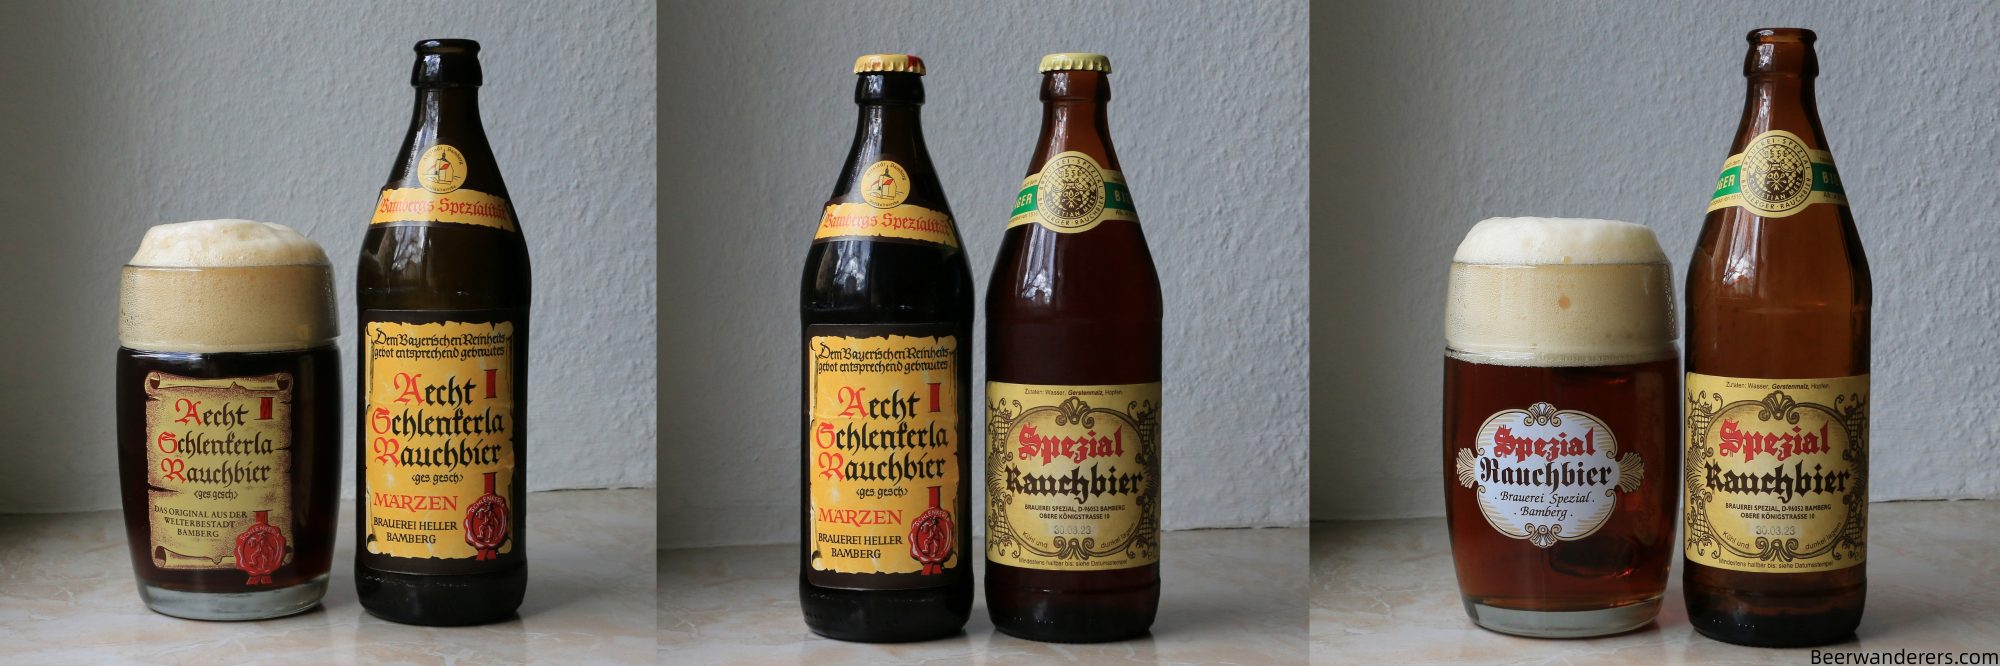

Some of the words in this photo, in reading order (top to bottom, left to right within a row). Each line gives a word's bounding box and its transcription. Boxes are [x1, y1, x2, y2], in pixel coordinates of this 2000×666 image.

[1782, 138, 1811, 170] SPEZIAL
[1076, 159, 1103, 188] SPEZIAL
[1750, 177, 1786, 200] CHRISTIAN
[1789, 177, 1803, 196] MERZ
[1780, 178, 1811, 209] RAUCHBIER
[1074, 196, 1104, 225] RAUCHBIER
[1083, 195, 1096, 212] MERZ
[374, 327, 398, 346] Dem
[399, 334, 462, 348] Bayerischen
[374, 348, 394, 360] gebot
[395, 348, 460, 361] entsprechend
[461, 346, 505, 361] gebrautes
[818, 342, 841, 360] Dem
[841, 347, 906, 362] Bayerischen
[818, 362, 838, 375] gebot
[839, 361, 903, 375] entsprechend
[904, 360, 949, 374] gebrautes
[393, 372, 476, 410] Aecht
[175, 398, 249, 432] Aecht
[837, 386, 921, 424] Aecht
[371, 406, 505, 442] Schlenkerla
[158, 431, 274, 459] Schlenkerla
[816, 420, 949, 456] Schlenkerla
[1018, 422, 1125, 466] Spezial
[1493, 424, 1597, 463] Spezial
[1719, 417, 1831, 463] Spezial
[373, 437, 502, 472] Rauchbier
[161, 457, 272, 488] Rauchbier
[818, 451, 946, 486] Rauchbier
[1480, 456, 1613, 494] Rauchbier
[1004, 462, 1144, 504] Rauchbier
[1704, 459, 1850, 504] Rauchbier
[373, 492, 459, 513] MÄRZEN
[1500, 491, 1545, 504] Brauerei
[1550, 491, 1590, 507] Spezial
[1725, 502, 1753, 511] BRAUEREI
[1754, 504, 1781, 513] SPEZIAL,
[1781, 504, 1804, 512] D-96052
[154, 504, 168, 514] DAS
[168, 507, 209, 518] ORIGINAL
[210, 511, 228, 519] AUS
[229, 511, 248, 519] DER
[164, 516, 236, 528] WELTERBESTADT
[818, 507, 904, 527] MÄRZEN
[1520, 506, 1568, 521] Bamberg
[1761, 512, 1808, 520] KÖNIGSTRASSE
[177, 528, 219, 538] BAMBERG
[373, 517, 417, 530] BRAUEREI
[419, 521, 458, 531] HELLER
[387, 532, 437, 544] BAMBERG
[818, 532, 862, 545] BRAUEREI
[864, 535, 903, 546] HELLER
[1736, 541, 1750, 549] und
[1805, 538, 1826, 550] dunkel
[831, 548, 881, 559] BAMBERG
